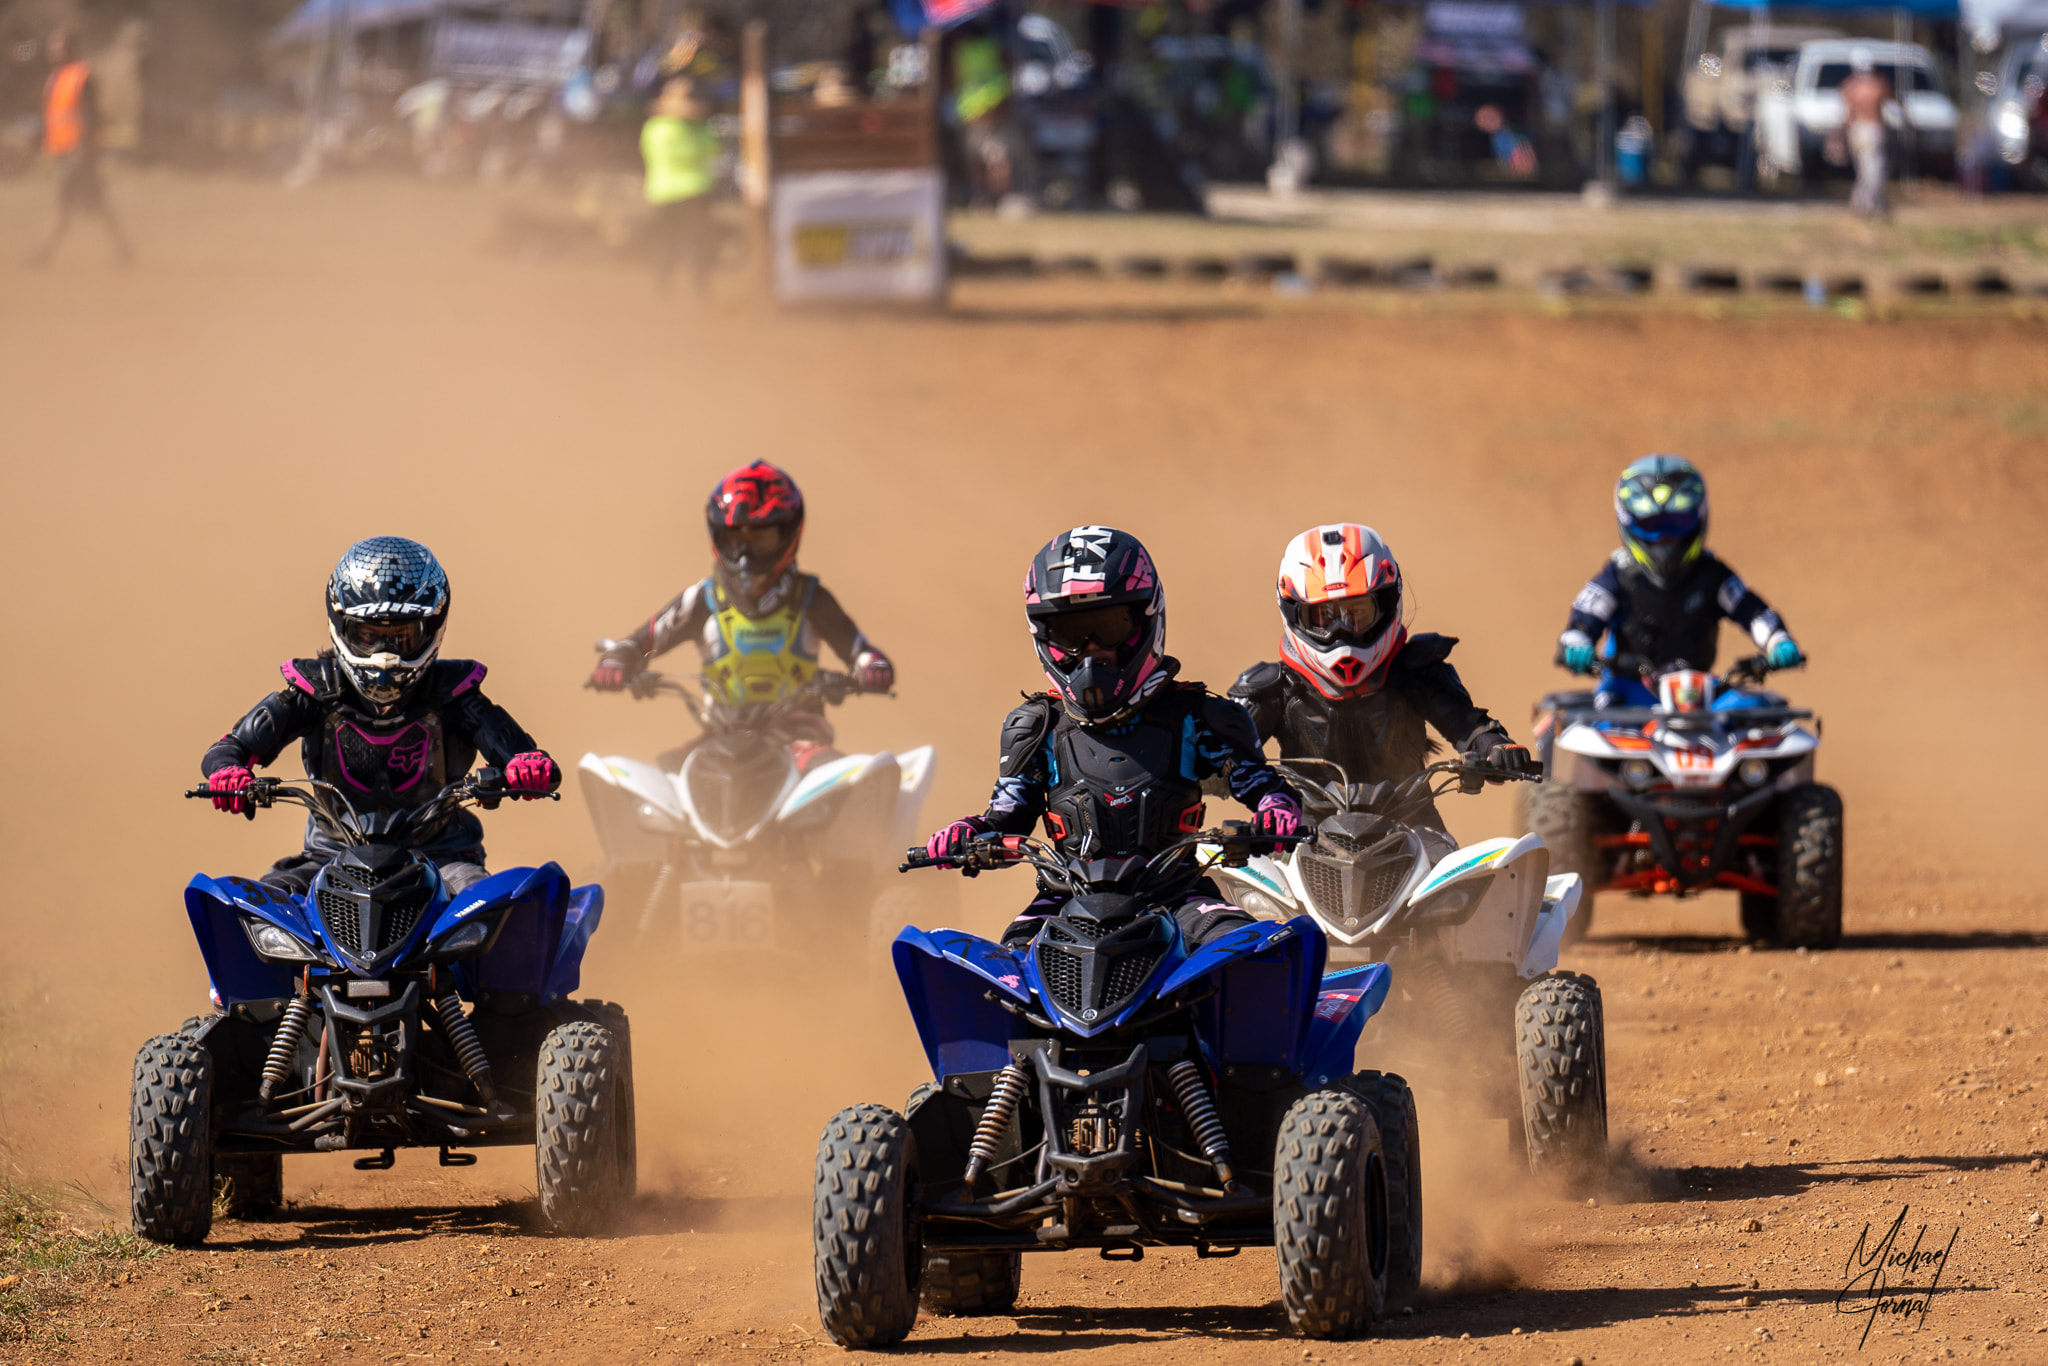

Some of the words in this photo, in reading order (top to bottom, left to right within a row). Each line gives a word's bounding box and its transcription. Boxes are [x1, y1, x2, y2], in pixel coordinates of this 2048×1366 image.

[344, 601, 434, 617] SHIFT
[454, 899, 487, 918] YAMAHA
[687, 900, 769, 943] 816
